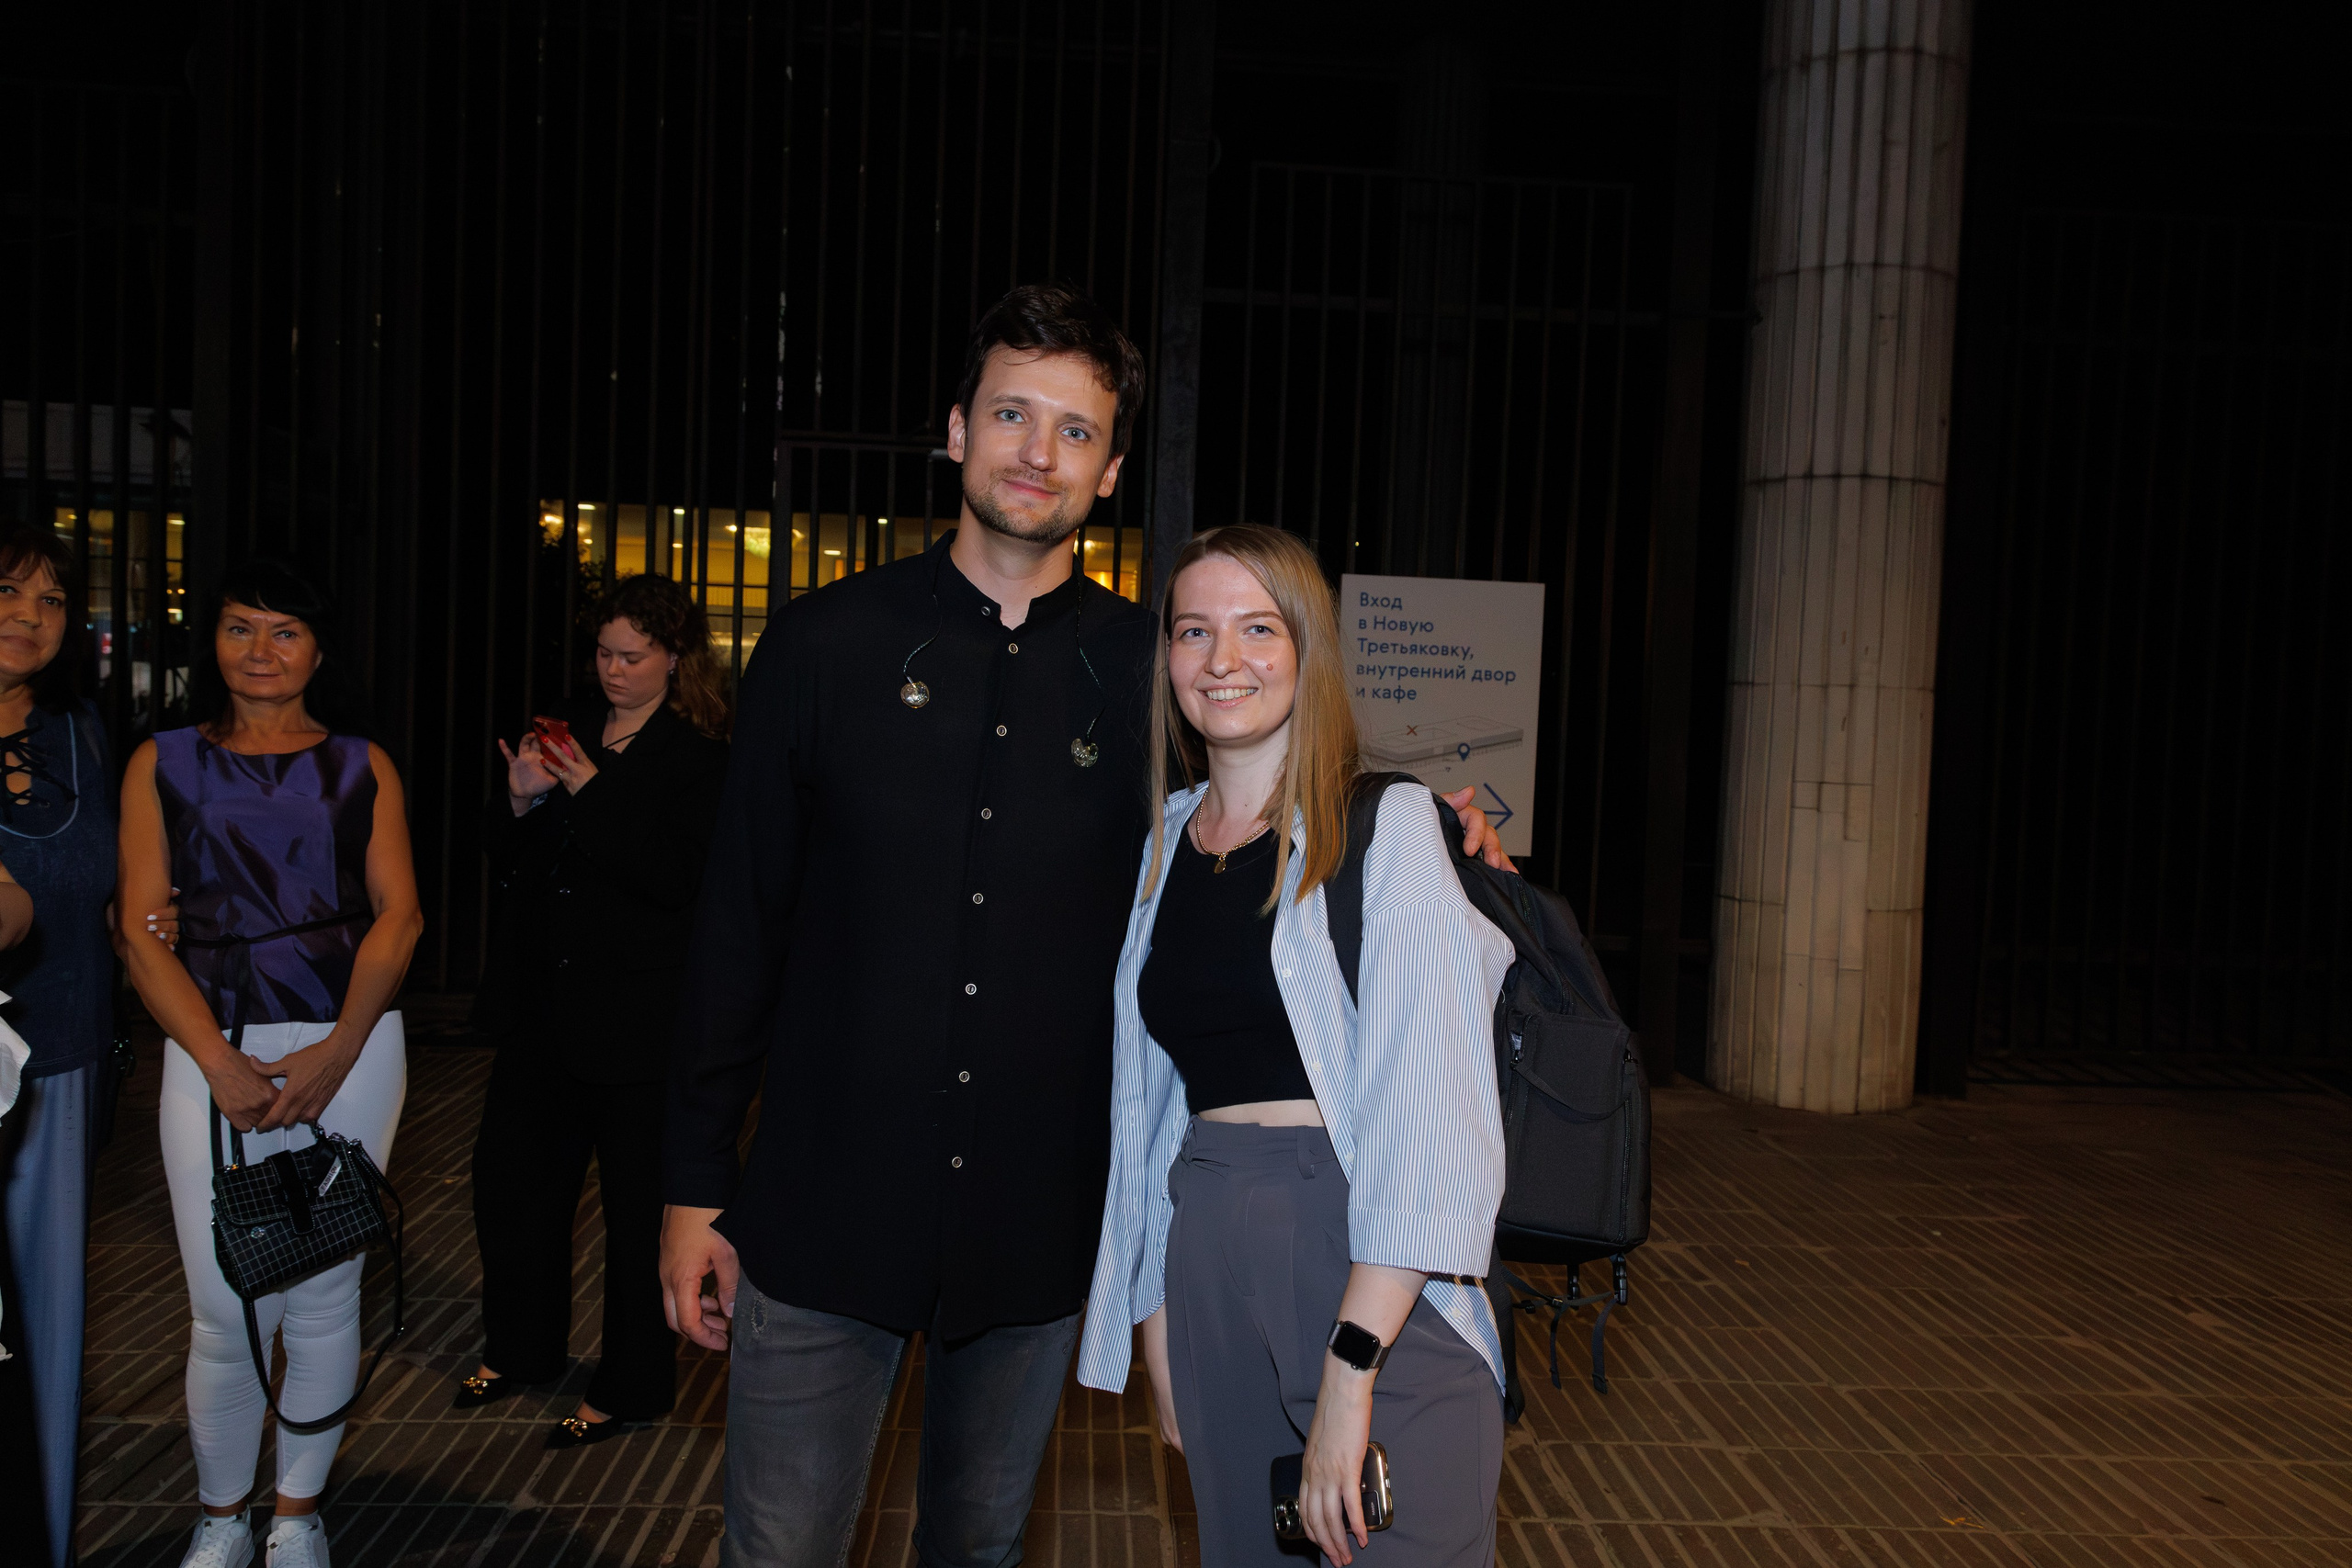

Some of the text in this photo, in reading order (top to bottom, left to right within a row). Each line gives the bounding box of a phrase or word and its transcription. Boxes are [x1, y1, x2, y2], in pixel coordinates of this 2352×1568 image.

[1360, 592, 1403, 610] Вход
[1358, 615, 1434, 636] в Новую
[1357, 637, 1475, 660] Третьяковку,
[1356, 663, 1517, 685] внутренний двор
[1355, 684, 1417, 703] и кафе
